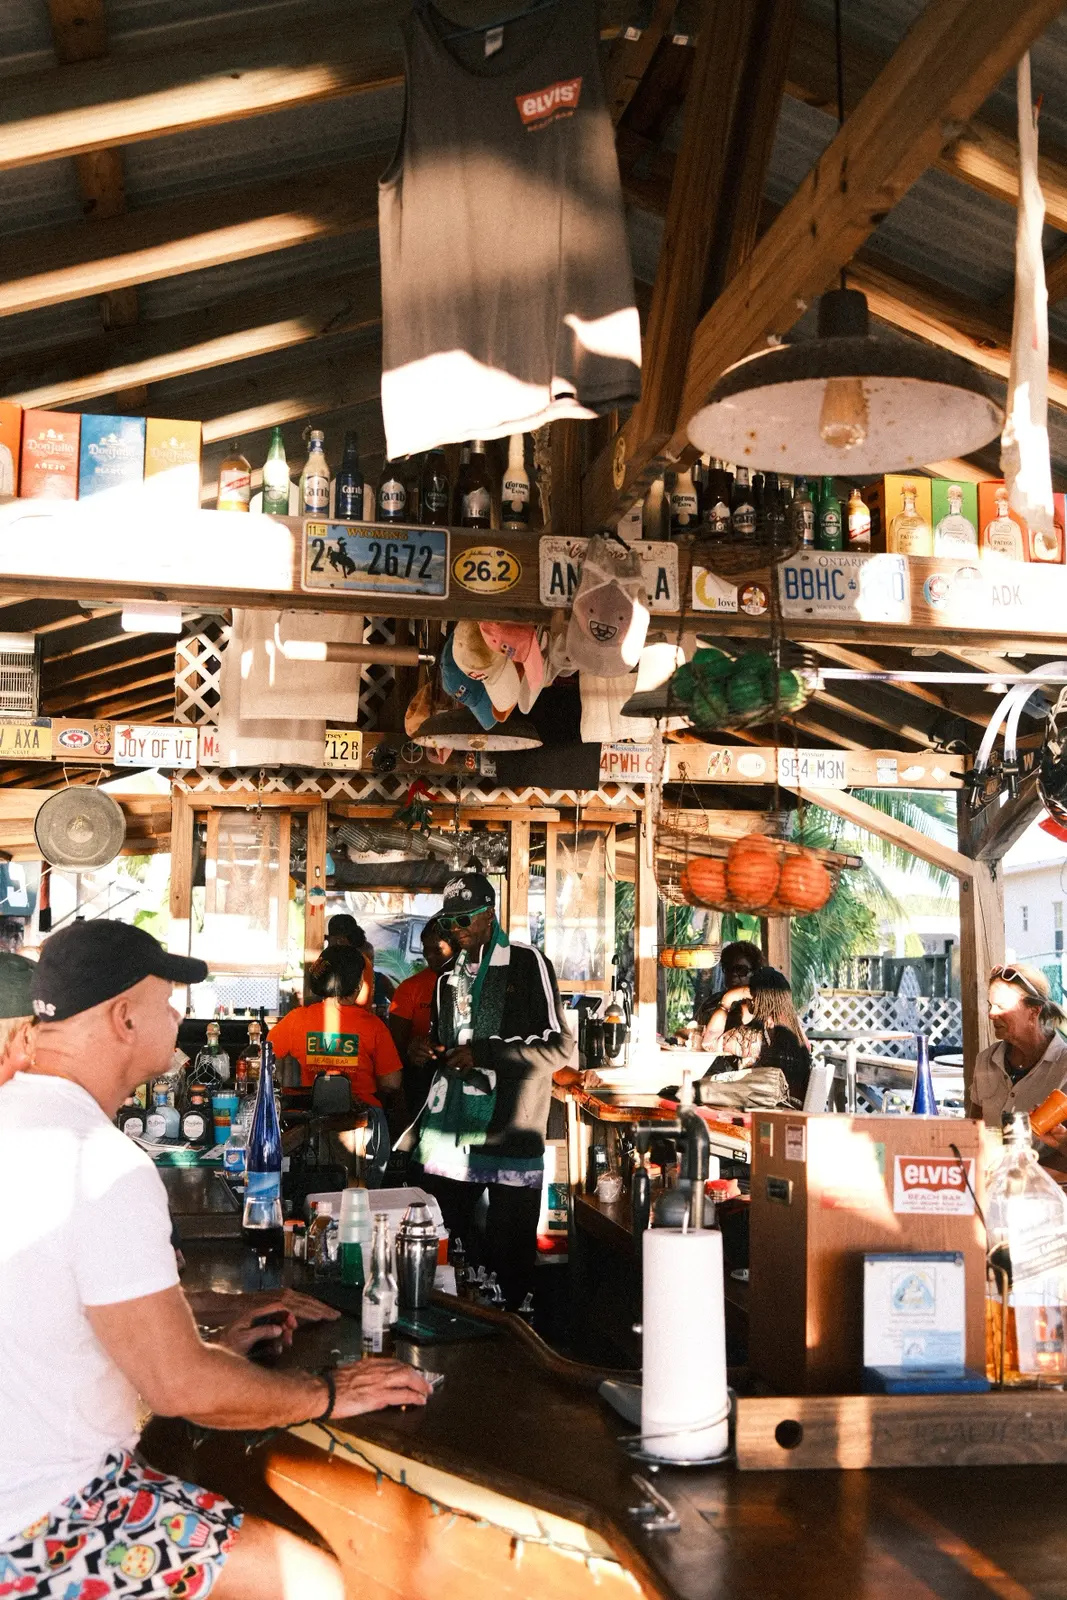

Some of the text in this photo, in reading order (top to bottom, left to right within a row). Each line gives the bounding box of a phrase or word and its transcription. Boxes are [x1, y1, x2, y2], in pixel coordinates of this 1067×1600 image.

[346, 527, 409, 541] WYOMING
[310, 538, 433, 579] 2 2672
[462, 560, 512, 582] 26.2
[784, 567, 847, 601] BBHC
[716, 598, 737, 608] love
[992, 584, 1023, 606] ADK
[15, 729, 41, 749] AXA
[118, 738, 192, 760] JOY OF VI
[600, 753, 640, 773] 4PWH
[816, 760, 845, 780] M3N
[307, 1036, 355, 1054] ELVIS
